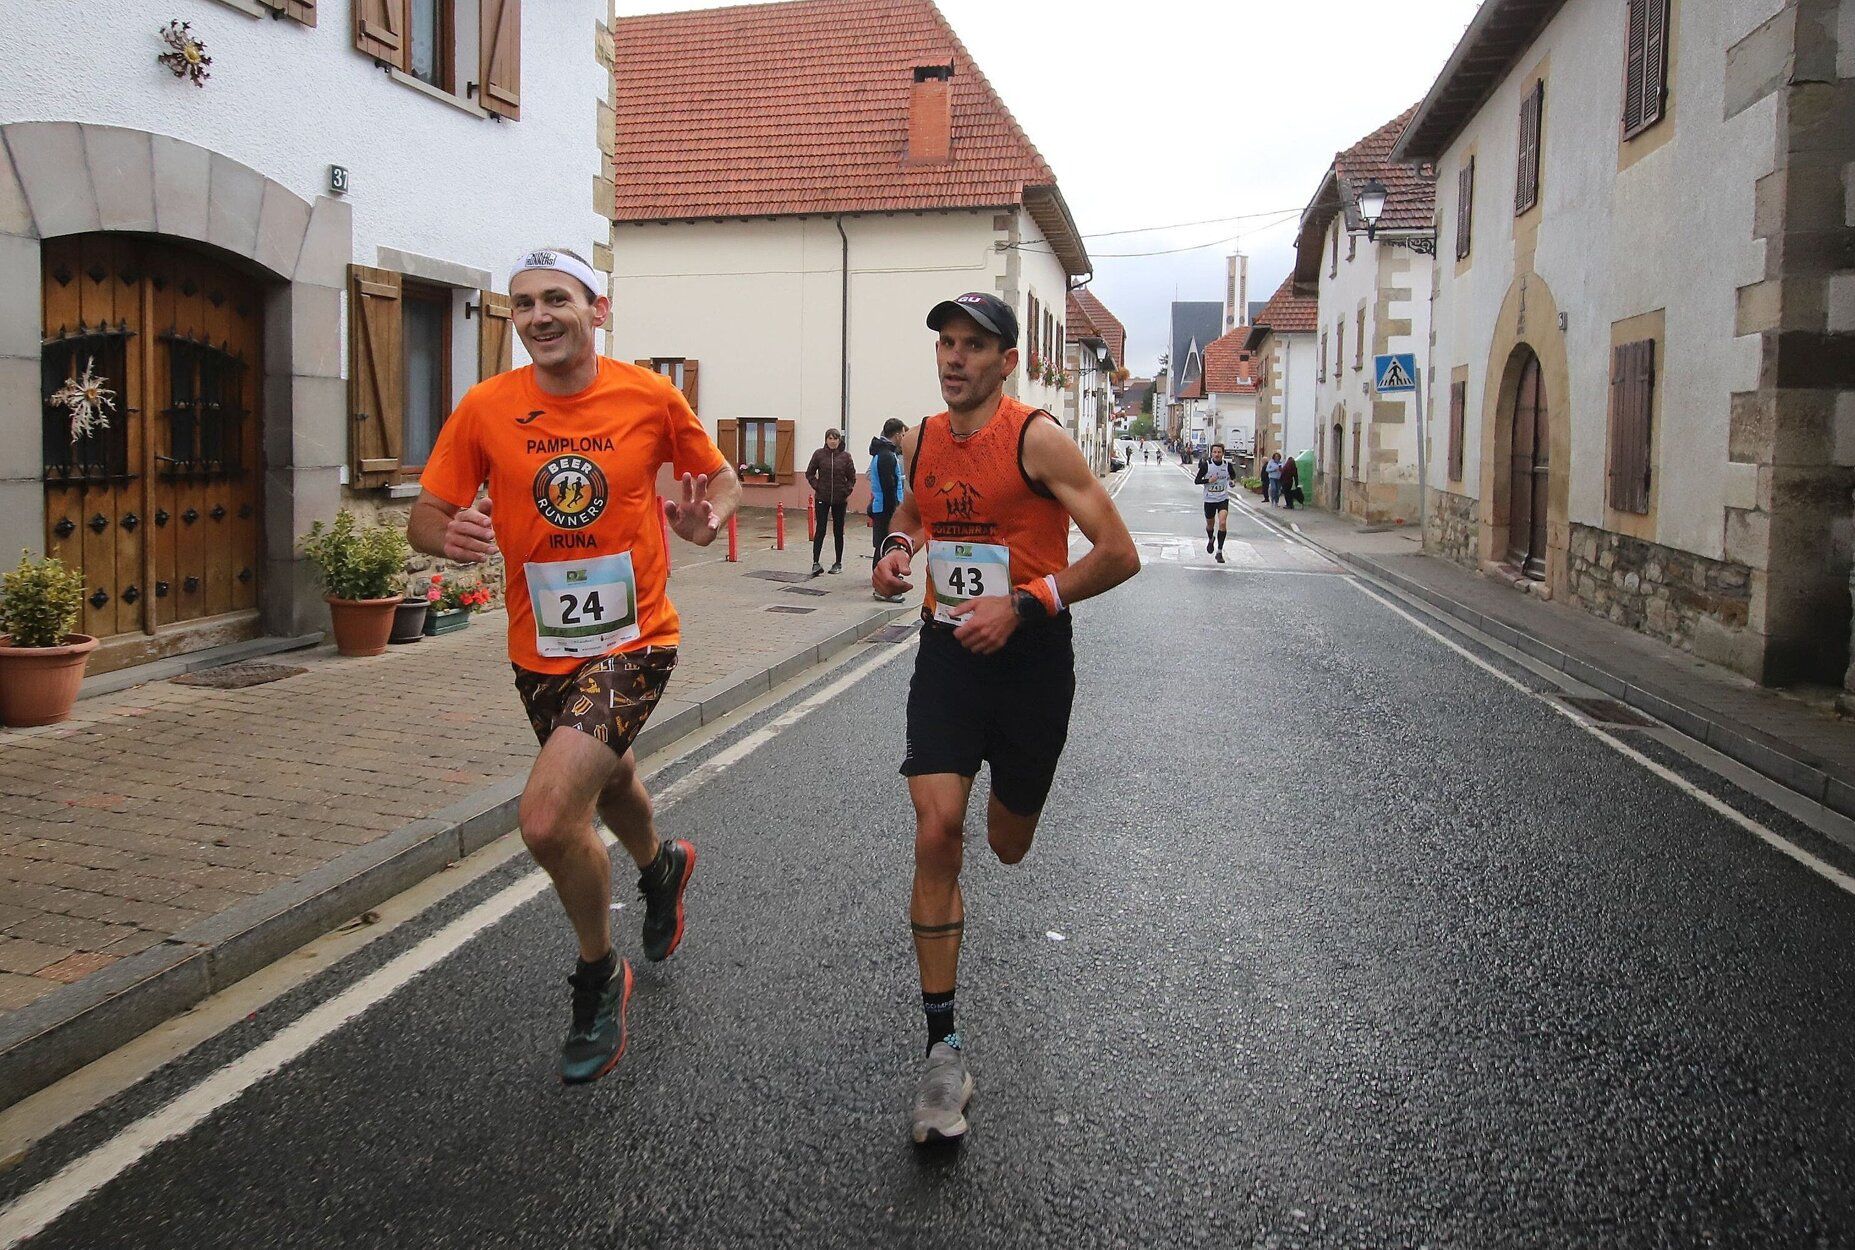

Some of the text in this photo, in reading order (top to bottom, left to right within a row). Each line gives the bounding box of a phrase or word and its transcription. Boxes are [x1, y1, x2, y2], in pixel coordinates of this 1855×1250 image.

[333, 168, 348, 189] 37
[527, 437, 615, 454] PAMPLONA
[547, 458, 592, 475] BEER
[538, 498, 604, 526] RUNNERS
[550, 531, 598, 548] IRUÑA
[948, 567, 985, 597] 43
[559, 591, 604, 625] 24
